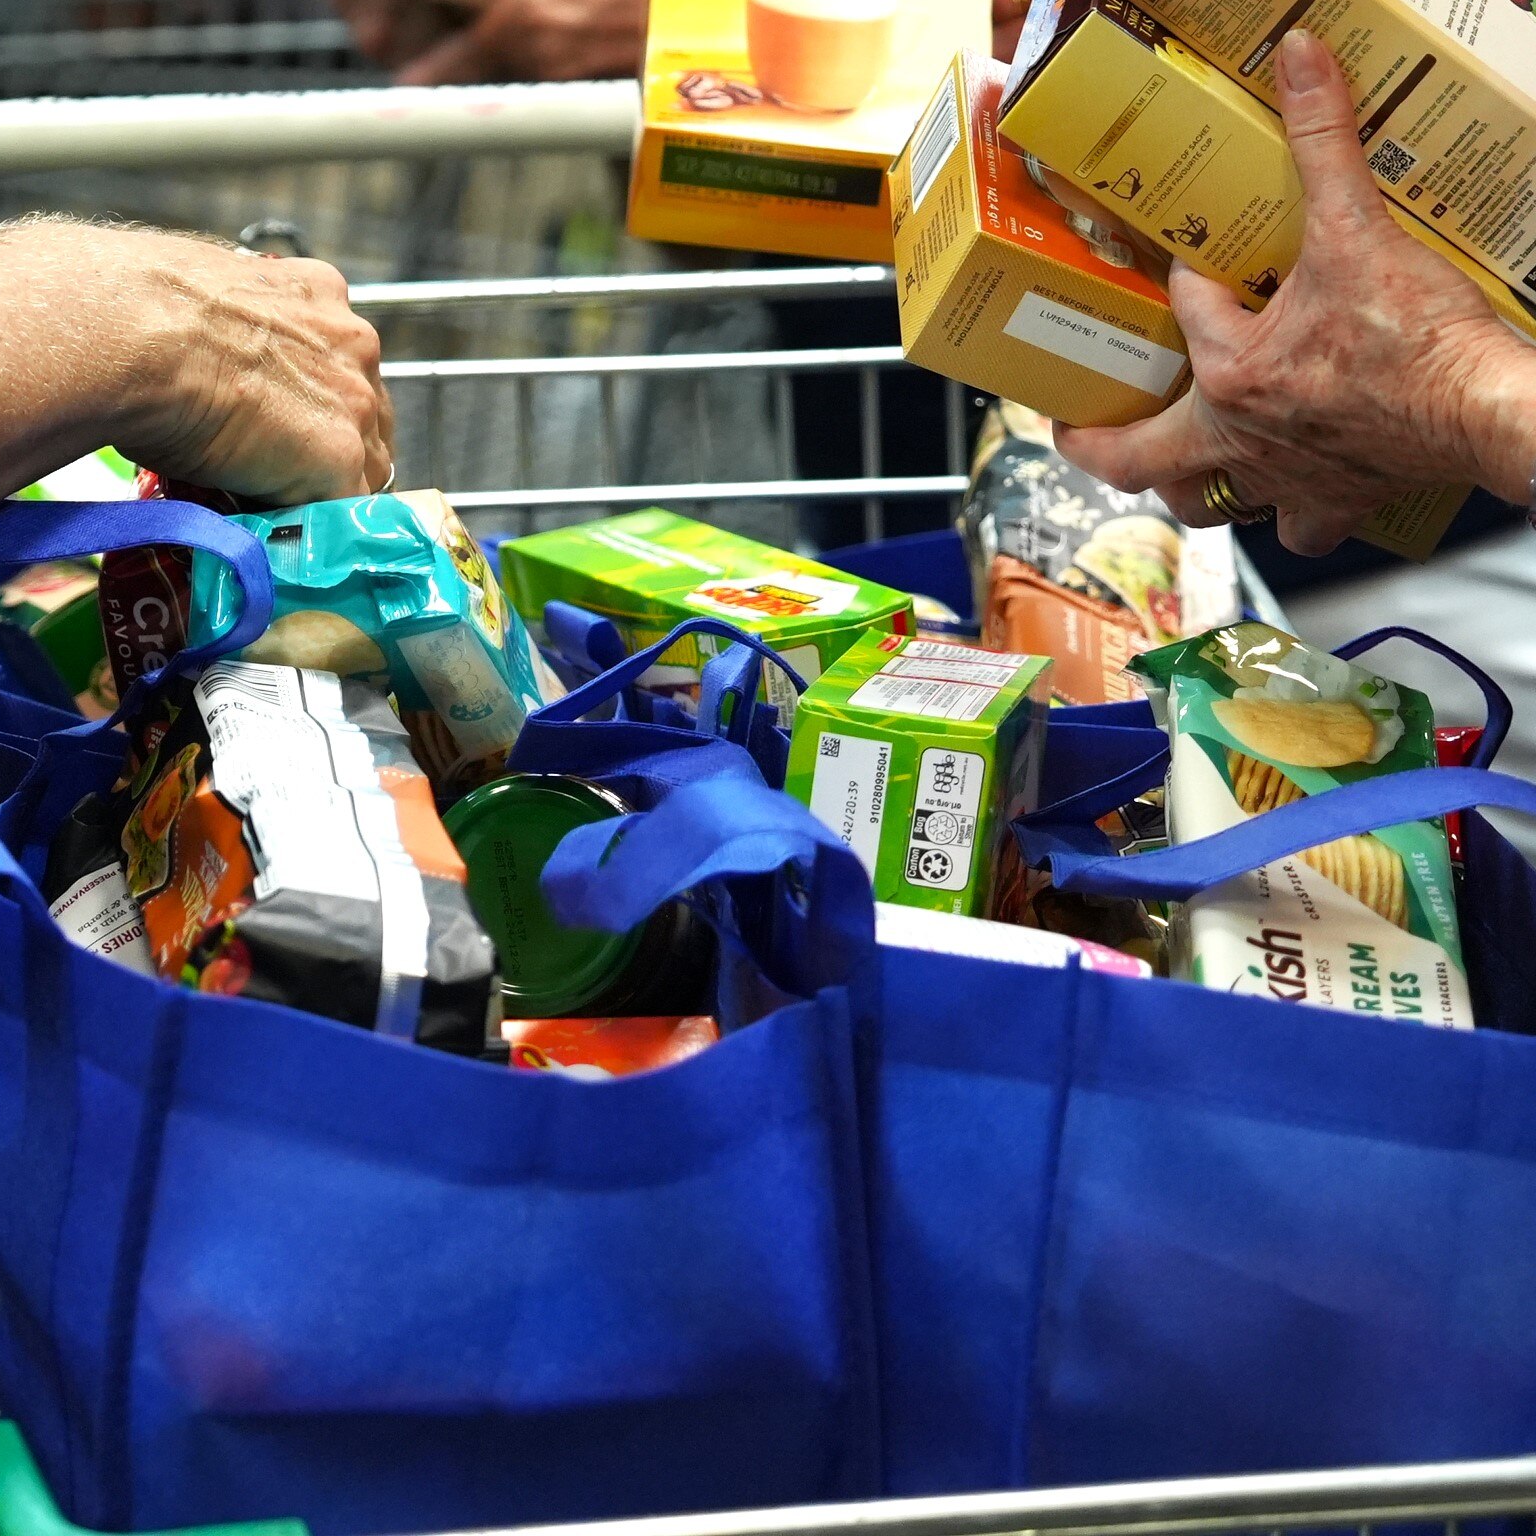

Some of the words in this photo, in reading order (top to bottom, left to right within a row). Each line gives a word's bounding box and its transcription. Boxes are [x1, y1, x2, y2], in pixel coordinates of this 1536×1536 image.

[1241, 40, 1272, 74] INGREDIENTS
[1368, 76, 1388, 98] CREAMER
[1384, 68, 1395, 79] AND
[983, 117, 992, 146] CALORIES
[1079, 156, 1095, 174] HOW
[1093, 146, 1104, 157] TO
[1100, 130, 1118, 148] MAKE
[1118, 105, 1138, 127] LITTLE
[1359, 126, 1373, 140] TALK
[986, 147, 994, 159] PER
[1135, 190, 1155, 213] EMPTY
[1152, 158, 1183, 193] CONTENTS
[1179, 148, 1191, 160] OF
[1187, 123, 1211, 150] SACHET
[1143, 201, 1159, 219] INTO
[1156, 184, 1174, 204] YOUR
[1171, 150, 1202, 186] FAVOURITE
[1023, 225, 1043, 241] 8
[1203, 240, 1221, 261] BEGIN
[1218, 231, 1229, 243] TO
[1226, 217, 1242, 234] STIR
[1238, 208, 1249, 219] AS
[1246, 194, 1261, 210] YOU
[1211, 247, 1229, 268] POUR
[1225, 240, 1235, 250] IN
[1231, 221, 1251, 244] 150ML
[1247, 212, 1259, 224] OF
[1256, 197, 1272, 215] HOT,
[1219, 258, 1233, 273] BUT
[1229, 245, 1244, 261] NOT
[1240, 219, 1265, 248] BOILING
[1262, 195, 1286, 223] WATER.
[979, 269, 1004, 304] STORAGE
[1033, 282, 1054, 298] BEST
[1057, 292, 1093, 314] BEFORE
[1102, 311, 1119, 325] LOT
[953, 303, 984, 348] DIRECTIONS
[107, 598, 136, 683] FAVOU
[869, 746, 889, 824] 910280995041
[924, 796, 961, 809] arl.org.au
[913, 815, 926, 833] Bag
[957, 824, 965, 843] Return
[493, 840, 505, 870] BEST
[907, 848, 919, 876] Carton
[1412, 850, 1435, 887] FREE
[53, 870, 116, 918] PRESERVATIVES
[498, 876, 512, 915] BEFORE
[1260, 863, 1271, 898] LIGH
[78, 909, 109, 933] herbs
[101, 909, 127, 928] with
[110, 900, 120, 909] &
[91, 926, 99, 934] a
[1347, 943, 1382, 1018] REAM
[1390, 971, 1423, 1024] VES
[1435, 961, 1452, 1011] CRACKERS
